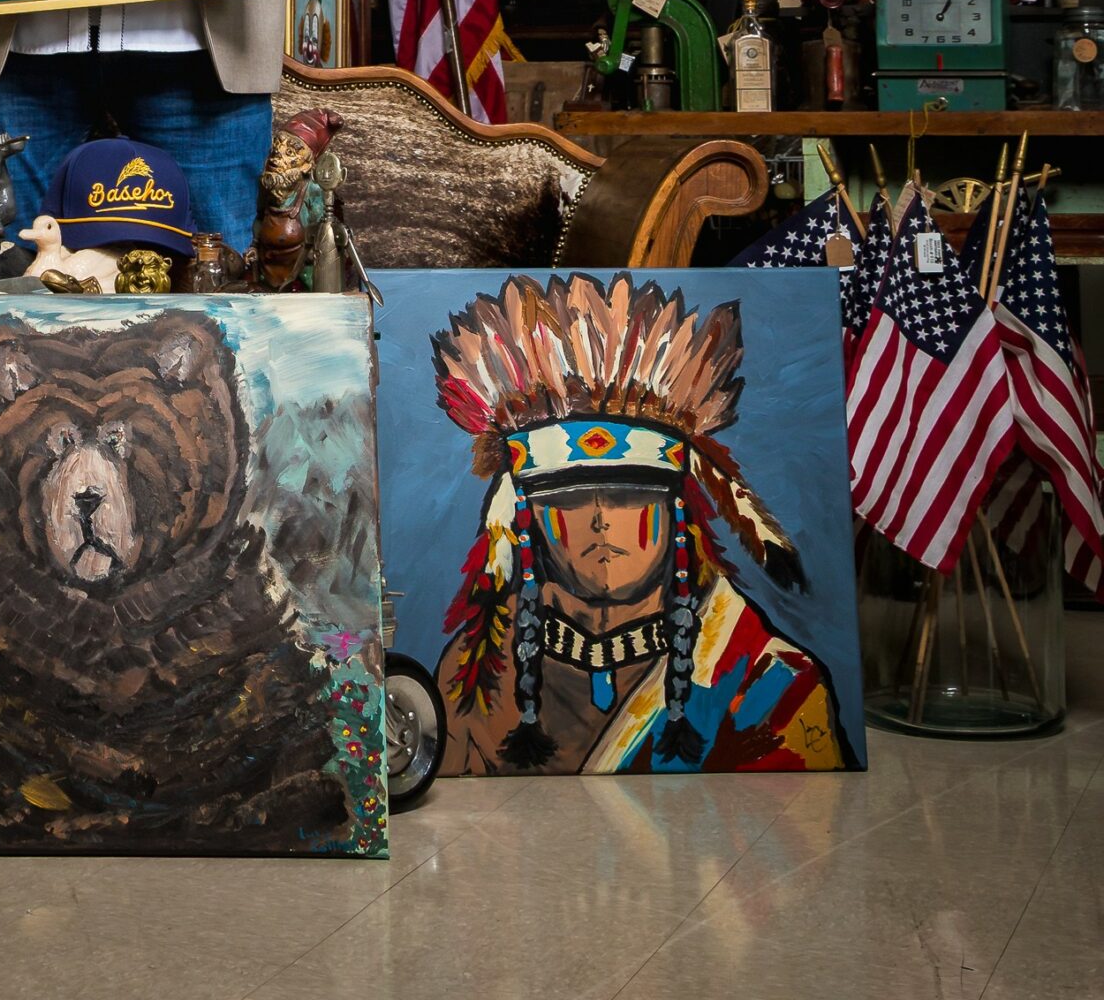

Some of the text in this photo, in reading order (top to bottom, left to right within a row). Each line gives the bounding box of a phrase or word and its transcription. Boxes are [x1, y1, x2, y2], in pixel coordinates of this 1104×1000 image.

[901, 13, 909, 22] 9
[972, 13, 981, 21] 3
[905, 28, 914, 36] 8
[967, 28, 976, 36] 4
[921, 35, 961, 43] 7 6 5
[87, 178, 174, 209] Basehor
